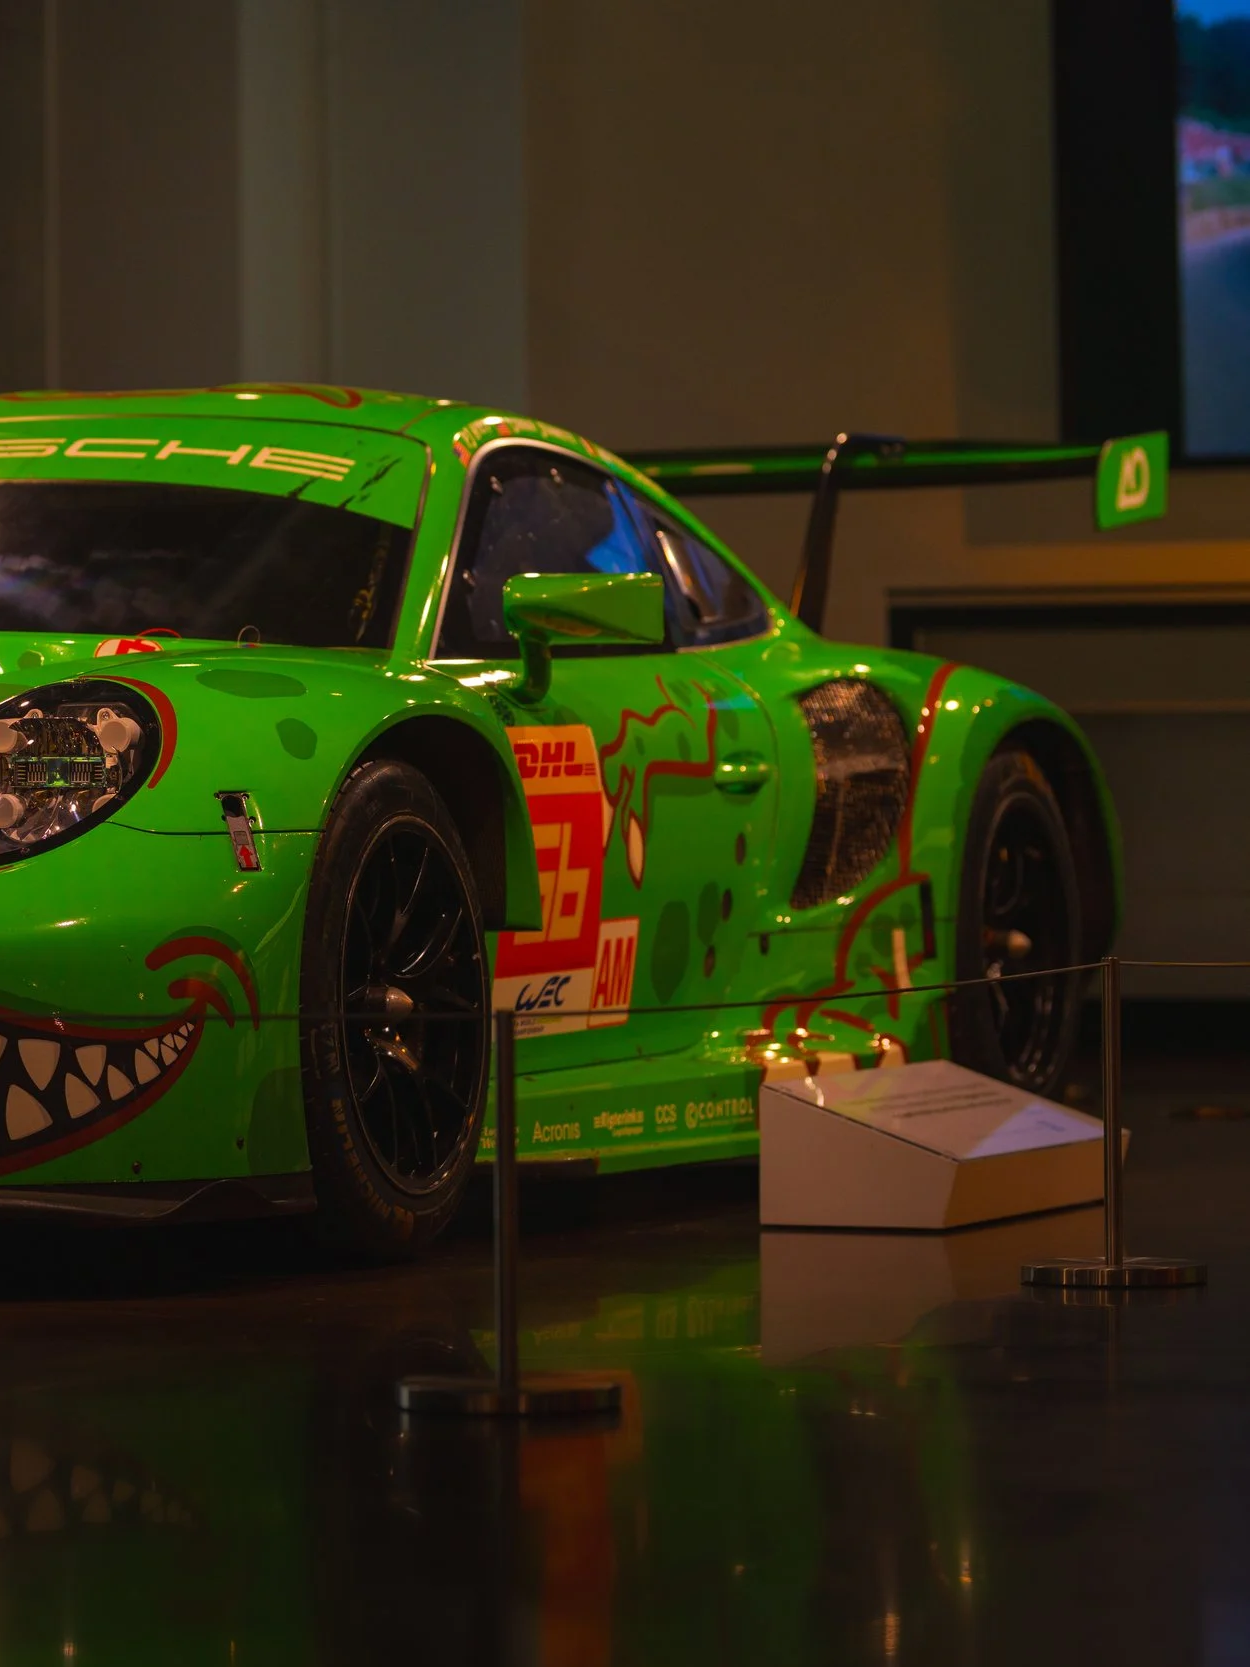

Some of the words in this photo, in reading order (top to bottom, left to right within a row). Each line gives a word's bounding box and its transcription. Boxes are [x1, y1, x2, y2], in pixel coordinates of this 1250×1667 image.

[513, 742, 576, 778] DHL
[592, 935, 636, 1009] AM
[515, 975, 572, 1011] WEC
[655, 1103, 678, 1124] CCS
[698, 1096, 754, 1120] CONTROL
[532, 1120, 581, 1143] Acronis
